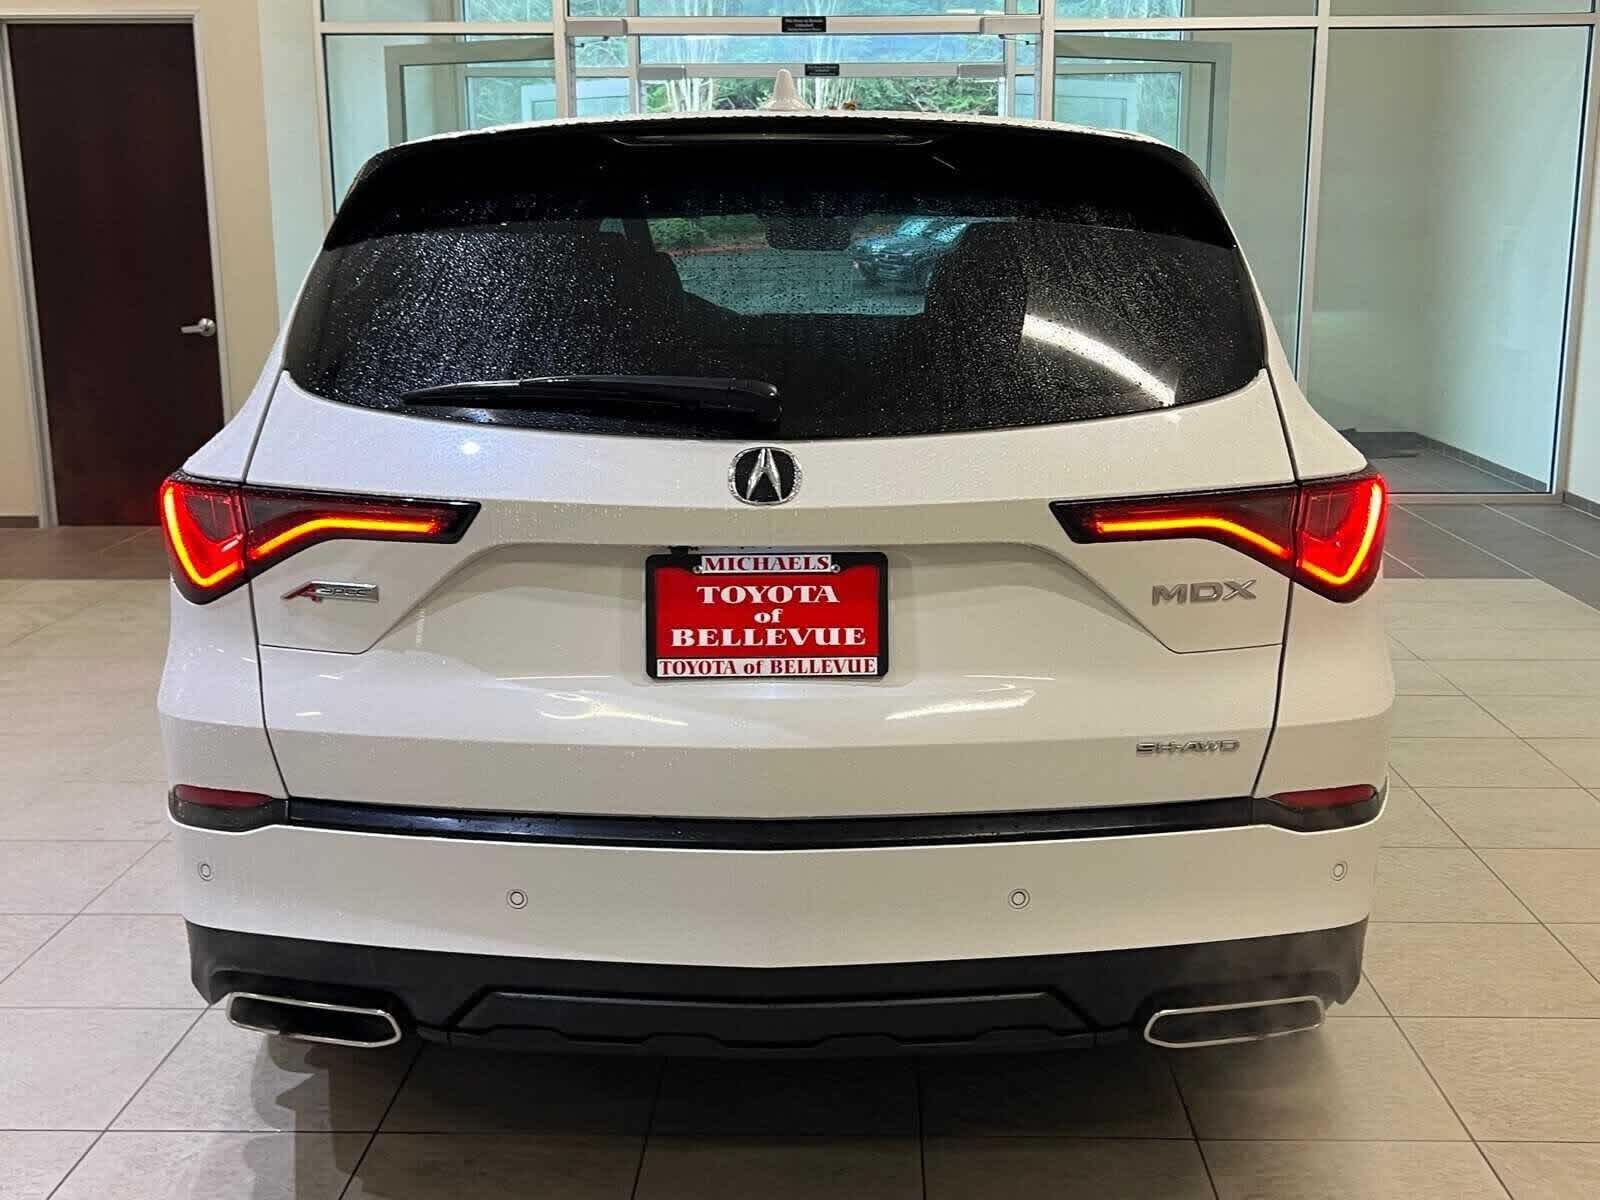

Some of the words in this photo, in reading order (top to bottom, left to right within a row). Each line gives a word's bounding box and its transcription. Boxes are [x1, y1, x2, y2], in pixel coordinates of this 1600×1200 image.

[704, 556, 830, 571] MICHAELS
[697, 585, 840, 603] TOYOTA
[1151, 579, 1257, 606] MDX
[754, 608, 783, 623] of
[671, 627, 866, 646] BELLEVUE
[659, 660, 736, 675] TOYOTA
[743, 659, 764, 674] of
[771, 658, 876, 674] BELLEVUE
[1135, 740, 1240, 754] SH-AWD
